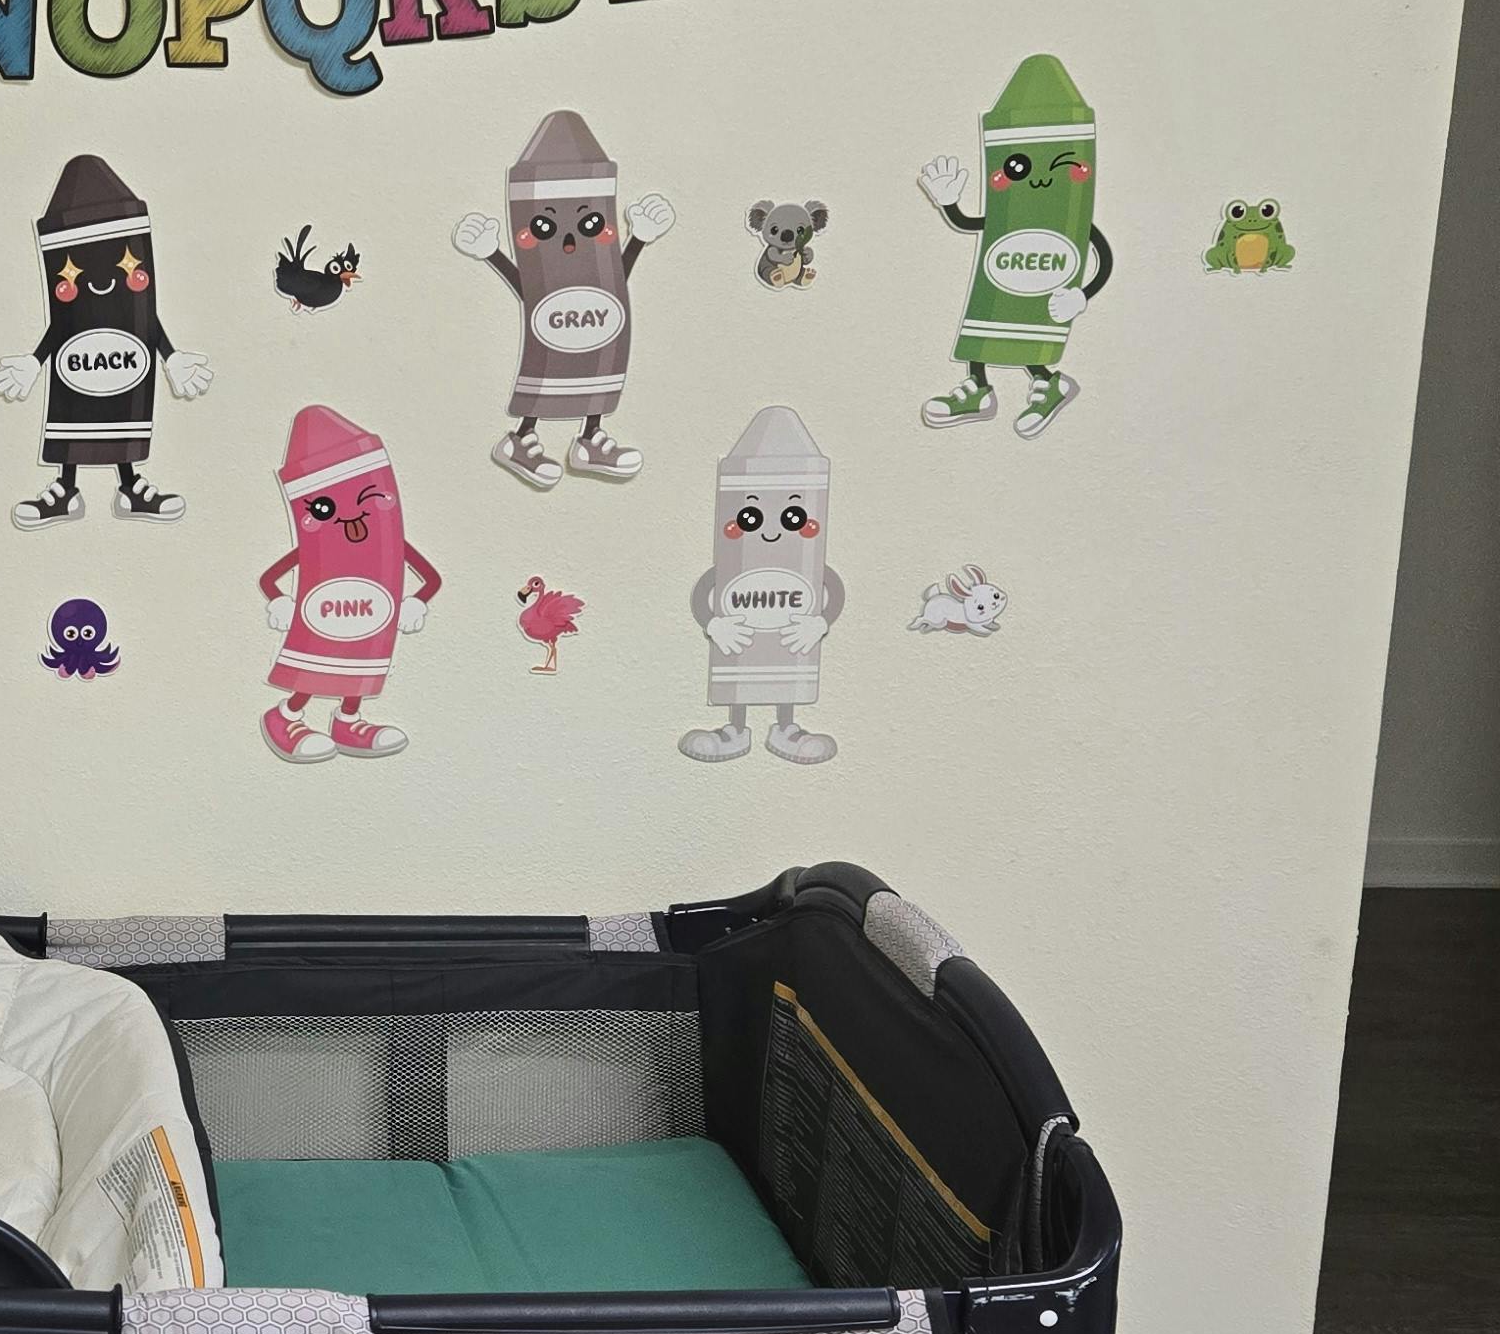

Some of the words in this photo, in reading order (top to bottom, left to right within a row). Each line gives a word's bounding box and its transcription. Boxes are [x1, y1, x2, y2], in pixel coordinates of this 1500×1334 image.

[995, 250, 1067, 273] GREEN
[547, 307, 609, 331] GRAY
[66, 350, 138, 373] BLACK
[320, 598, 374, 618] PINK
[731, 589, 803, 611] WHITE
